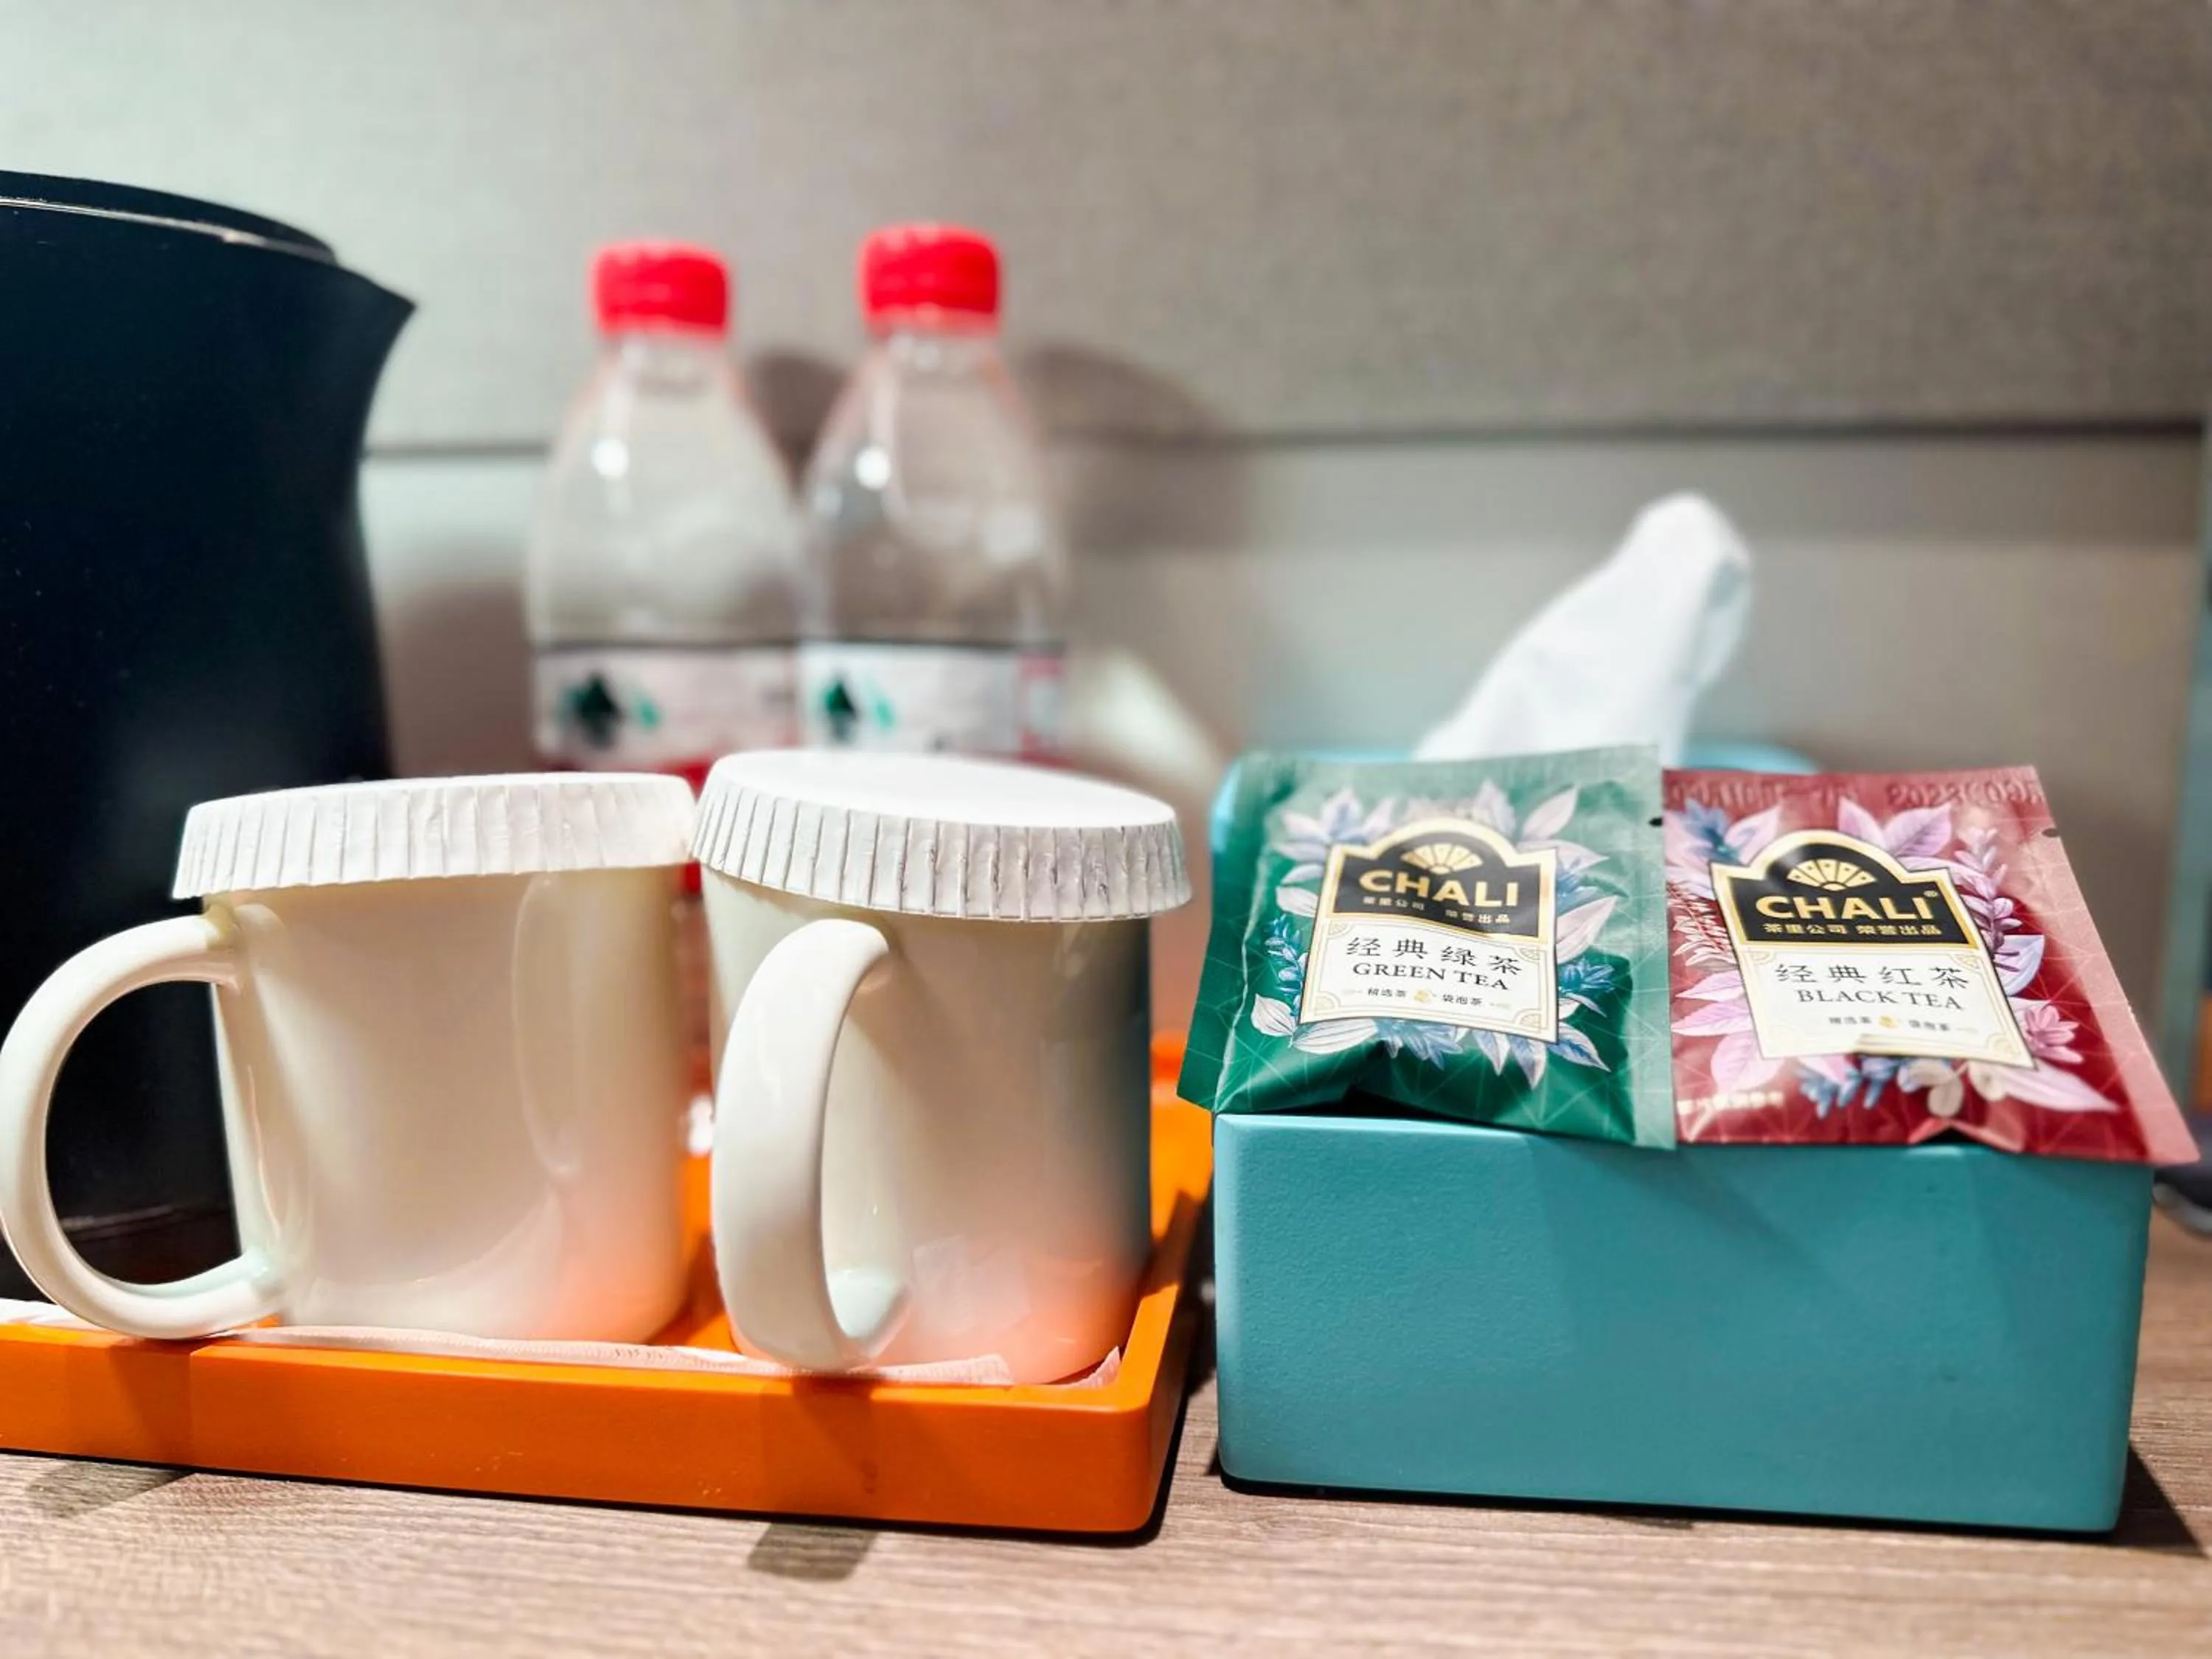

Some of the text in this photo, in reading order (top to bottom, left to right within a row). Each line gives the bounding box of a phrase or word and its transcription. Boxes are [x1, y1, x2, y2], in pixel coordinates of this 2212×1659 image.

[1359, 869, 1519, 908] CHALI
[1756, 895, 1934, 920] CHALI
[1346, 936, 1523, 975] 经典绿茶
[1353, 962, 1510, 991] GREEN TEA
[1775, 963, 1970, 990] 经典红茶
[1796, 989, 1966, 1011] BLACK TEA
